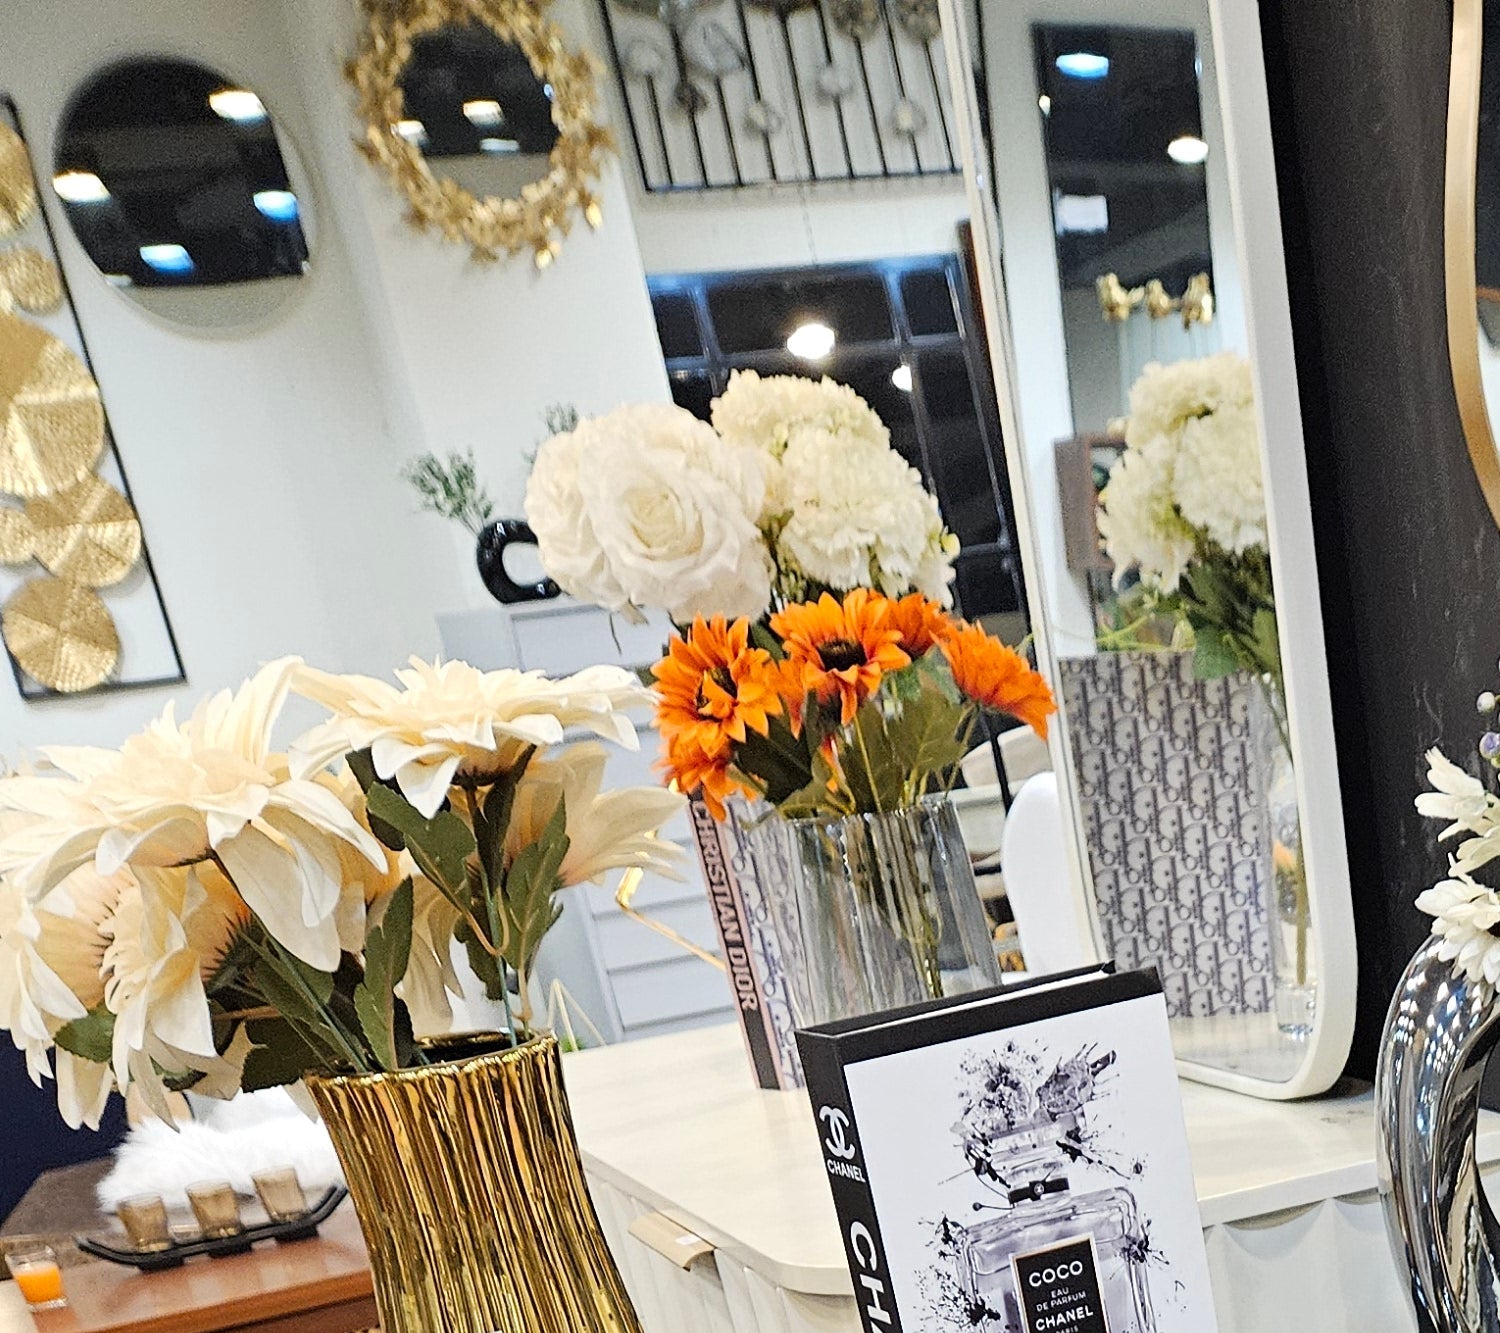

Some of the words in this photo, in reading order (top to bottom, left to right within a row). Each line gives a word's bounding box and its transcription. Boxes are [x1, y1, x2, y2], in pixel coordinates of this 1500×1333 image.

[727, 946, 758, 1011] DIOR
[827, 1158, 866, 1183] CHANEL
[1028, 1260, 1083, 1287] COCO
[1036, 1301, 1049, 1312] DE
[1050, 1290, 1087, 1308] PARFUM
[1050, 1286, 1070, 1299] EAU
[1035, 1305, 1094, 1331] CHANEL
